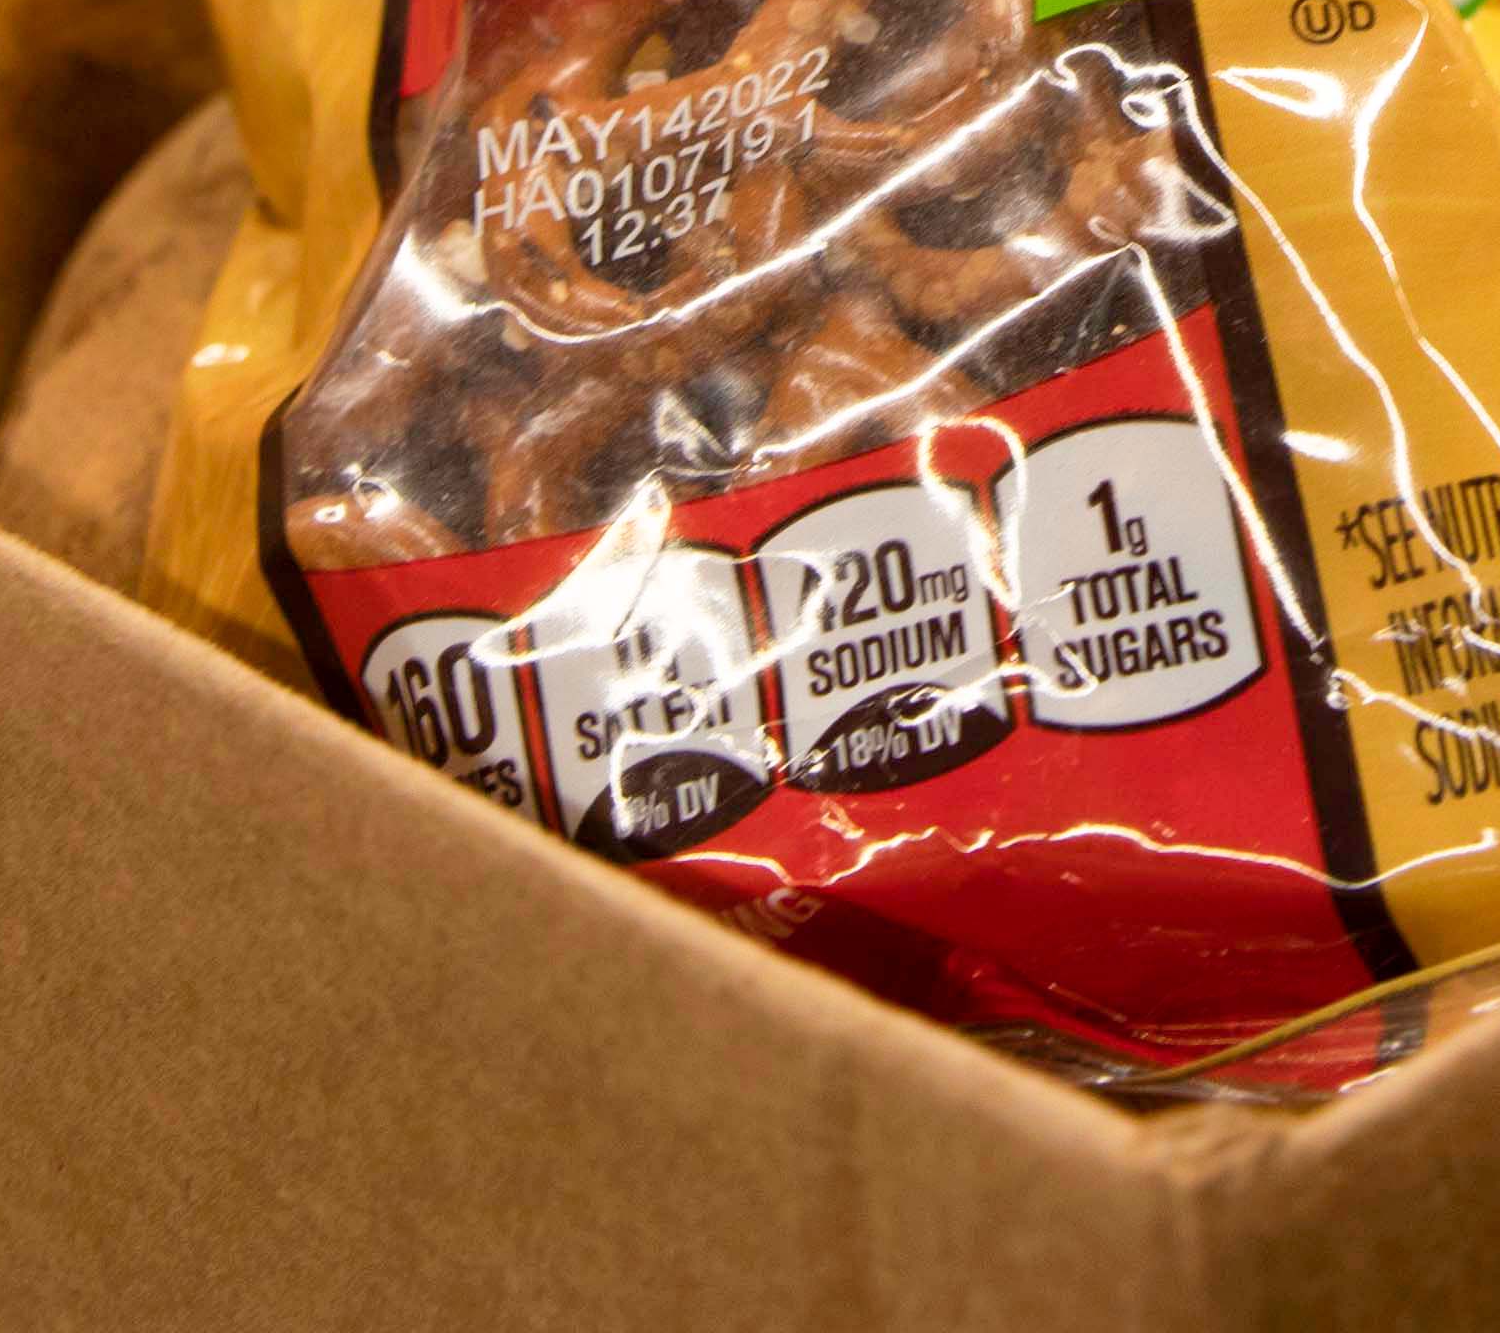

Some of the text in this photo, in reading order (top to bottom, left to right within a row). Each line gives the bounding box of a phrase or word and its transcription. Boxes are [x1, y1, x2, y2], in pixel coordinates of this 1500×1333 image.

[580, 176, 731, 267] 12:37
[1088, 480, 1146, 557] 1g
[1063, 557, 1200, 626] TOTAL
[808, 610, 968, 696] SODIUM
[1054, 610, 1230, 690] SUGARS
[384, 636, 498, 771] 160
[676, 772, 720, 823] DV
